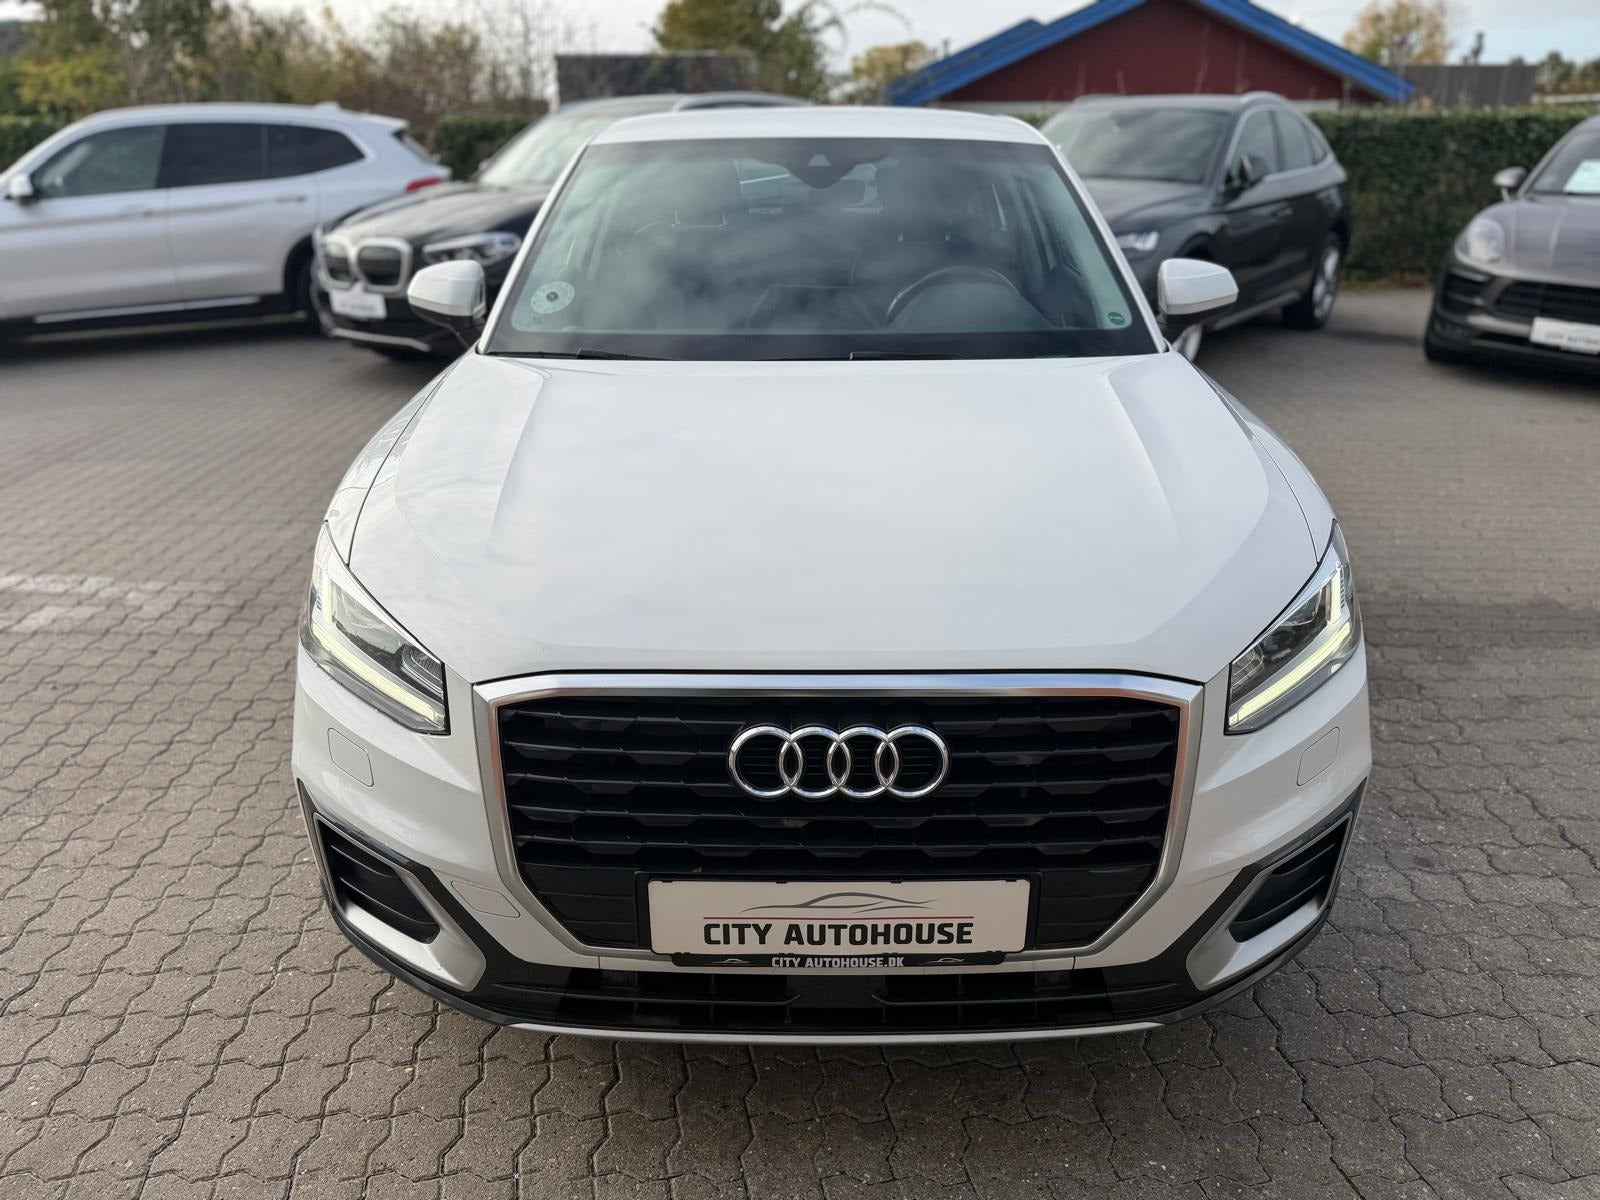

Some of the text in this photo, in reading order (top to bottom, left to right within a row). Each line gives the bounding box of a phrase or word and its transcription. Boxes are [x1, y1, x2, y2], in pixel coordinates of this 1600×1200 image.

[703, 922, 974, 946] CITY AUTOHOUSE
[771, 956, 905, 968] CITY AUTOHOUSE.DK
